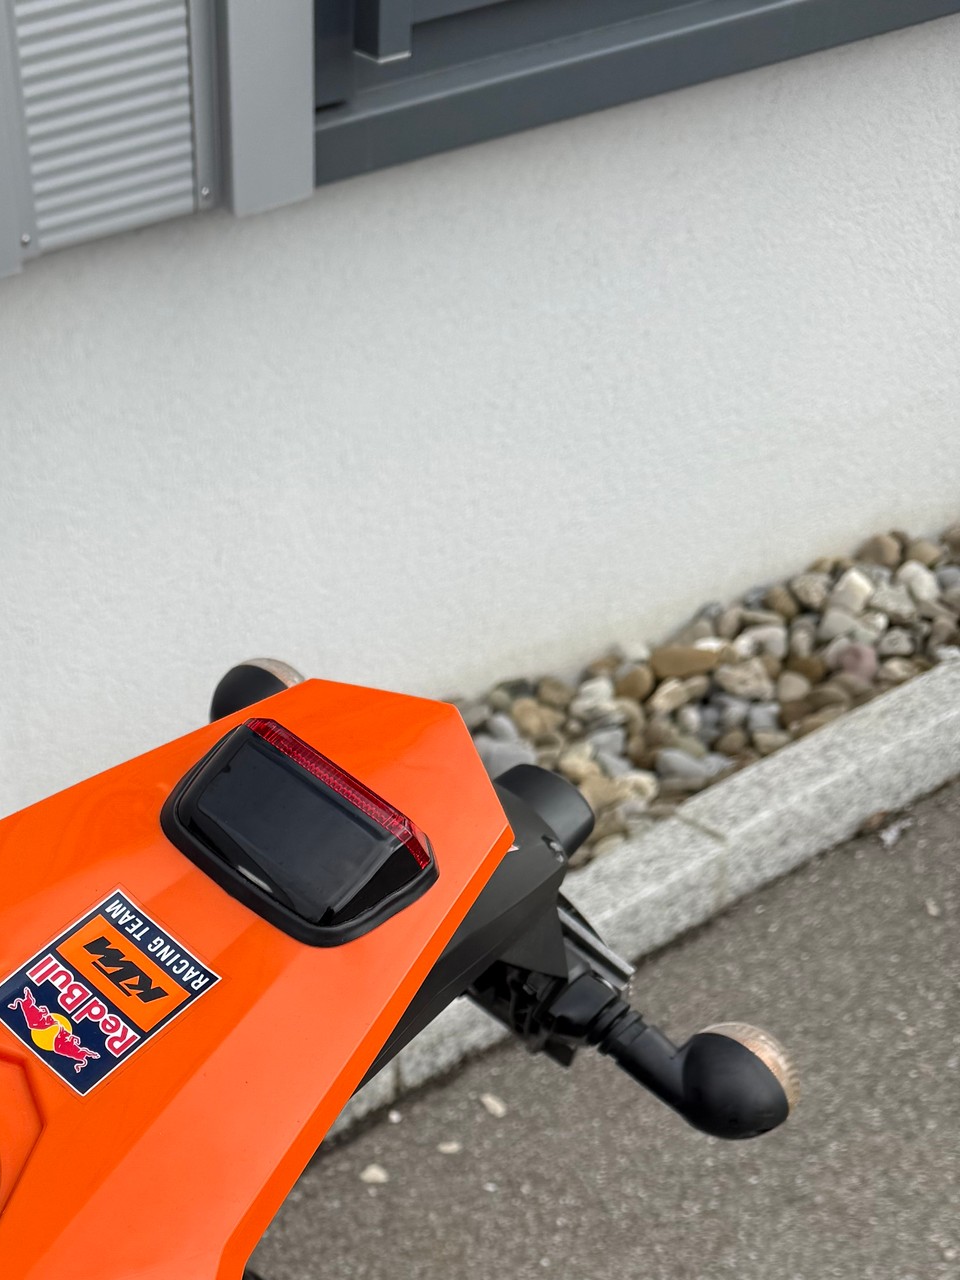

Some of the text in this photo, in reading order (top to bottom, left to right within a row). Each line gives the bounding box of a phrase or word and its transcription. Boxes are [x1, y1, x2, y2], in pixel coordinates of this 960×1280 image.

[83, 936, 169, 1003] KTM
[105, 899, 209, 991] RACING TEAM
[26, 953, 140, 1058] Red Bull
